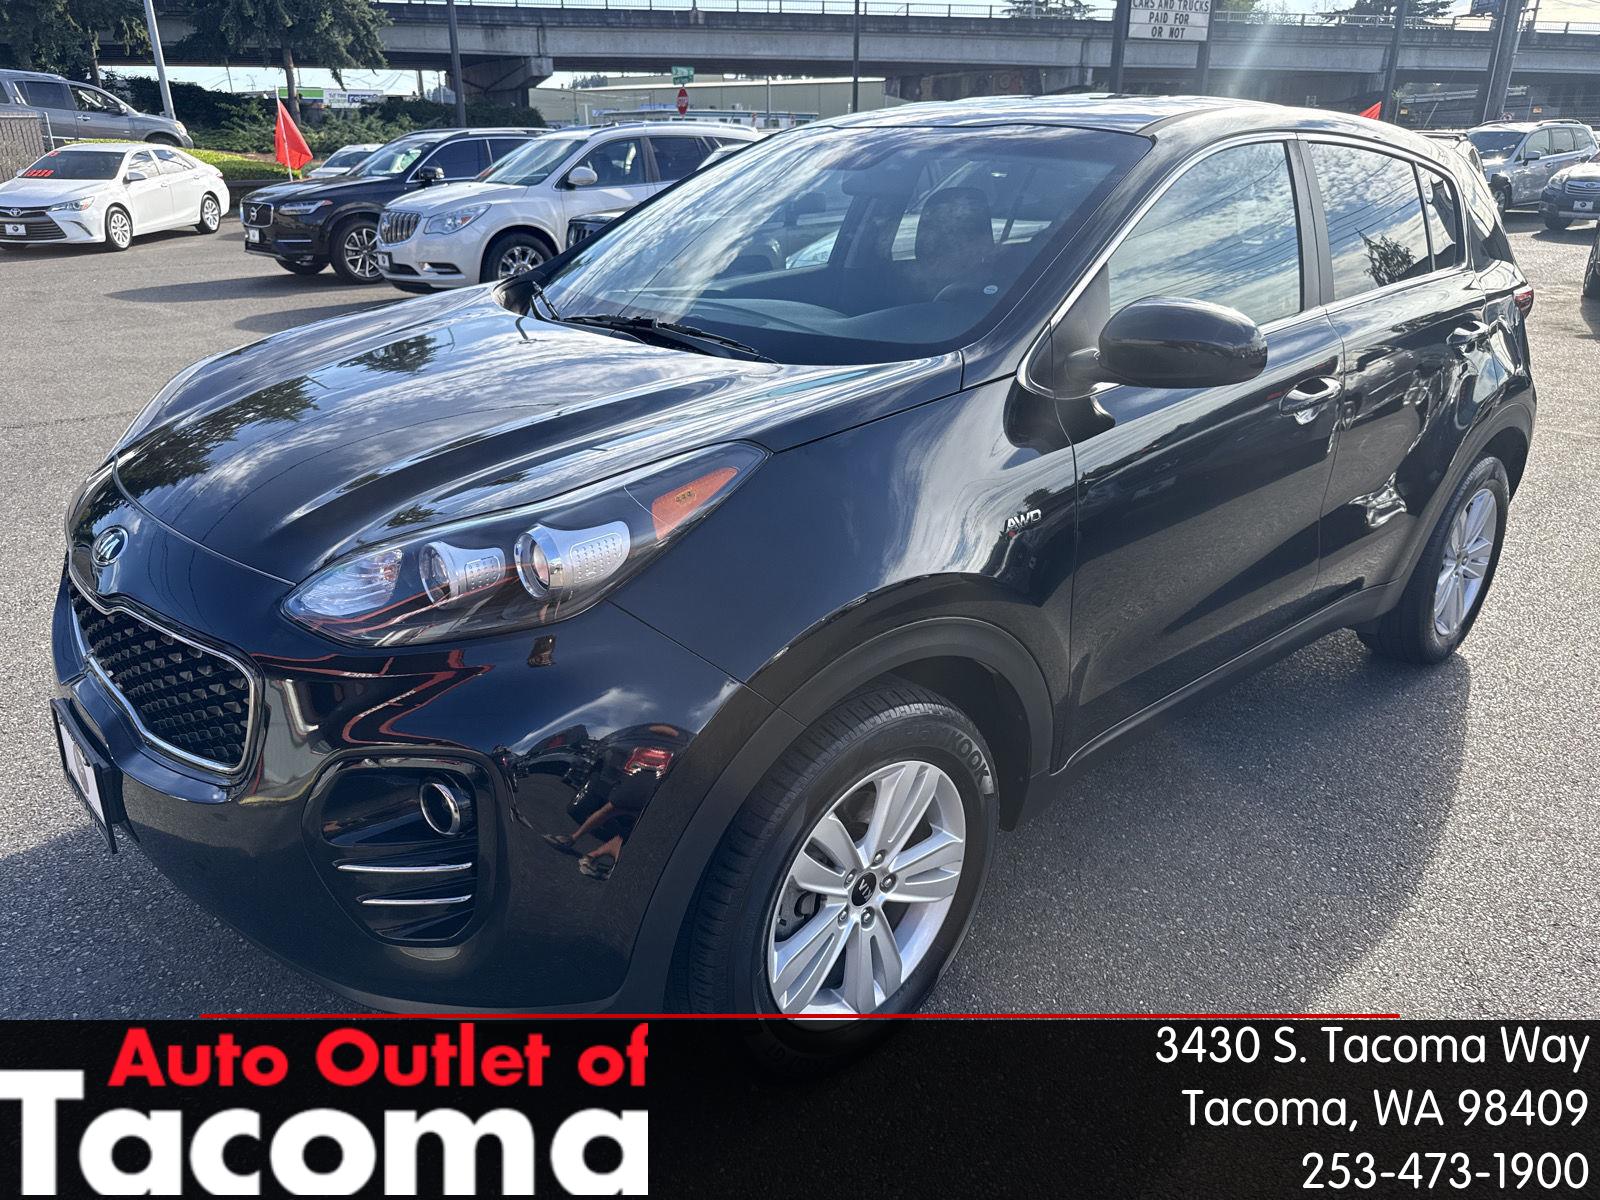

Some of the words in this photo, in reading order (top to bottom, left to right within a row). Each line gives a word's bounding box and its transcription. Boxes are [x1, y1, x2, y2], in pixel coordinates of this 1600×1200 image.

[1132, 0, 1155, 9] CARS
[1158, 0, 1175, 10] AND
[1178, 0, 1209, 12] TRUCKS
[1148, 12, 1168, 23] PAID
[1174, 13, 1190, 25] FOR
[1151, 26, 1164, 38] OR
[1169, 28, 1186, 39] NOT
[1006, 508, 1042, 533] AWD
[858, 878, 873, 902] KIA
